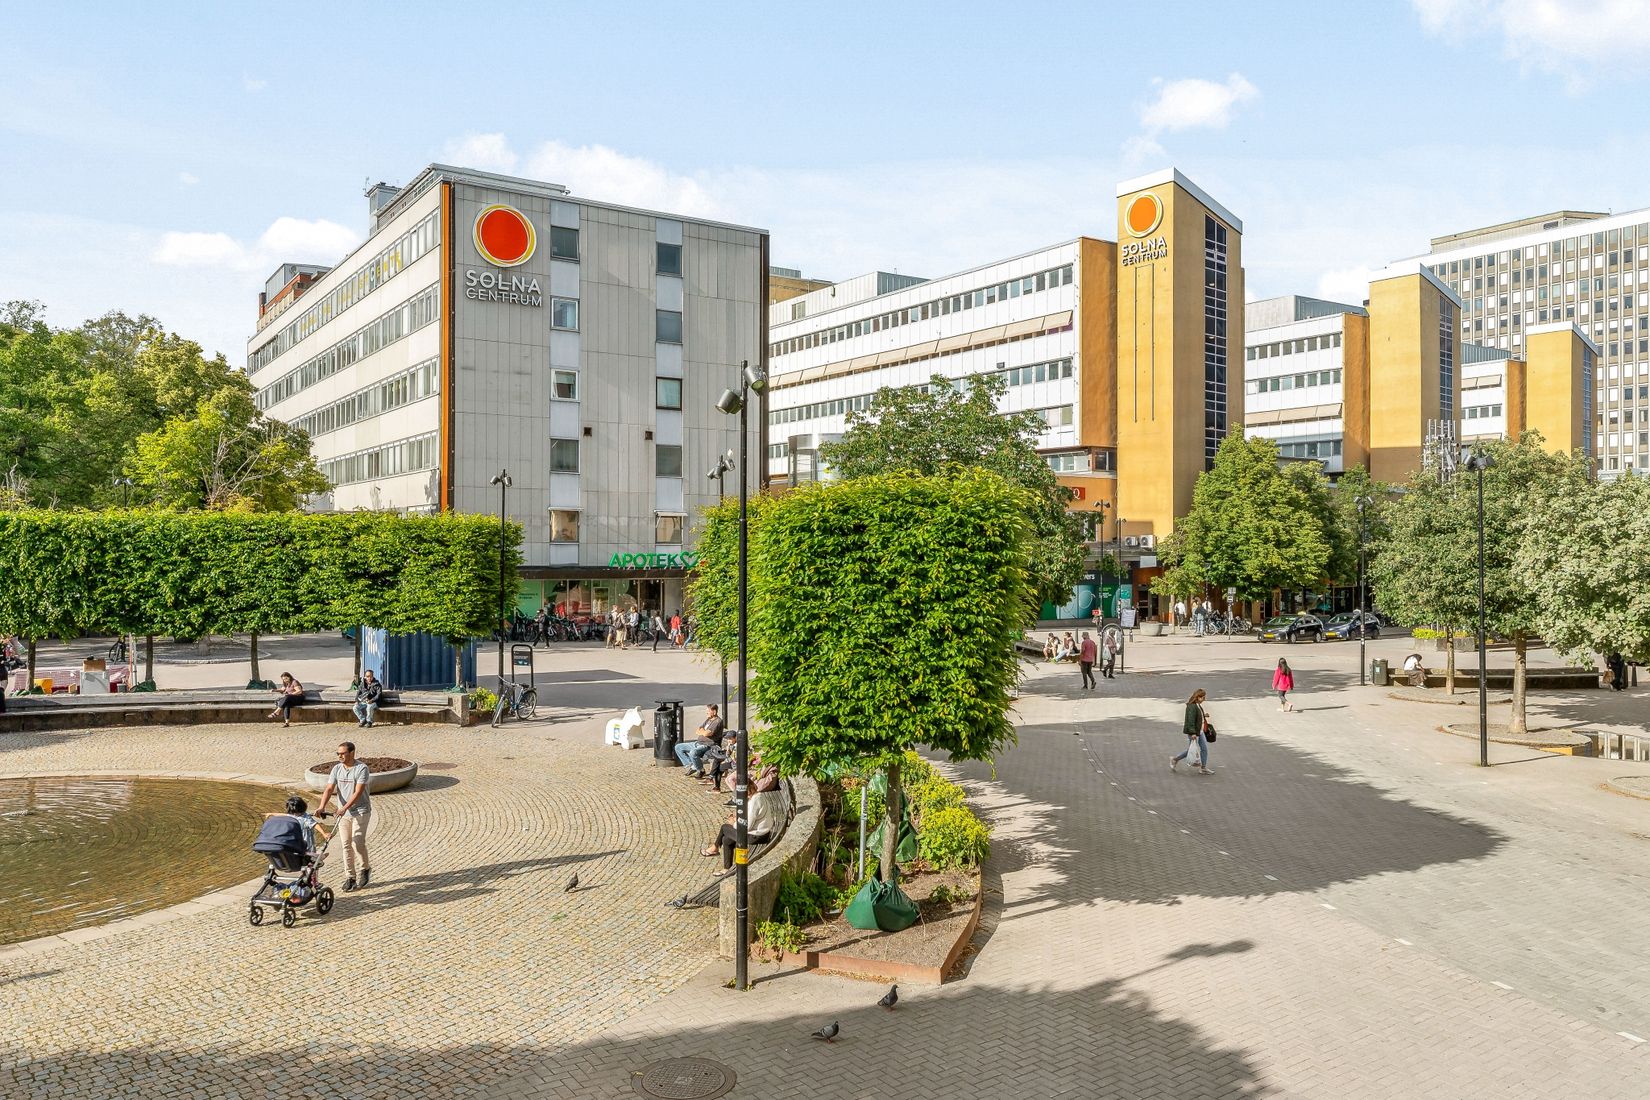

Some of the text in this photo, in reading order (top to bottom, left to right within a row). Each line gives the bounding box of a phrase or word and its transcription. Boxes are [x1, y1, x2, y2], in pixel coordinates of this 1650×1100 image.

[1122, 236, 1168, 257] SOLNA
[1122, 249, 1168, 266] CENTRUM
[465, 269, 541, 294] SOLNA
[466, 288, 542, 307] CENTRUM
[608, 552, 680, 568] APOTEK
